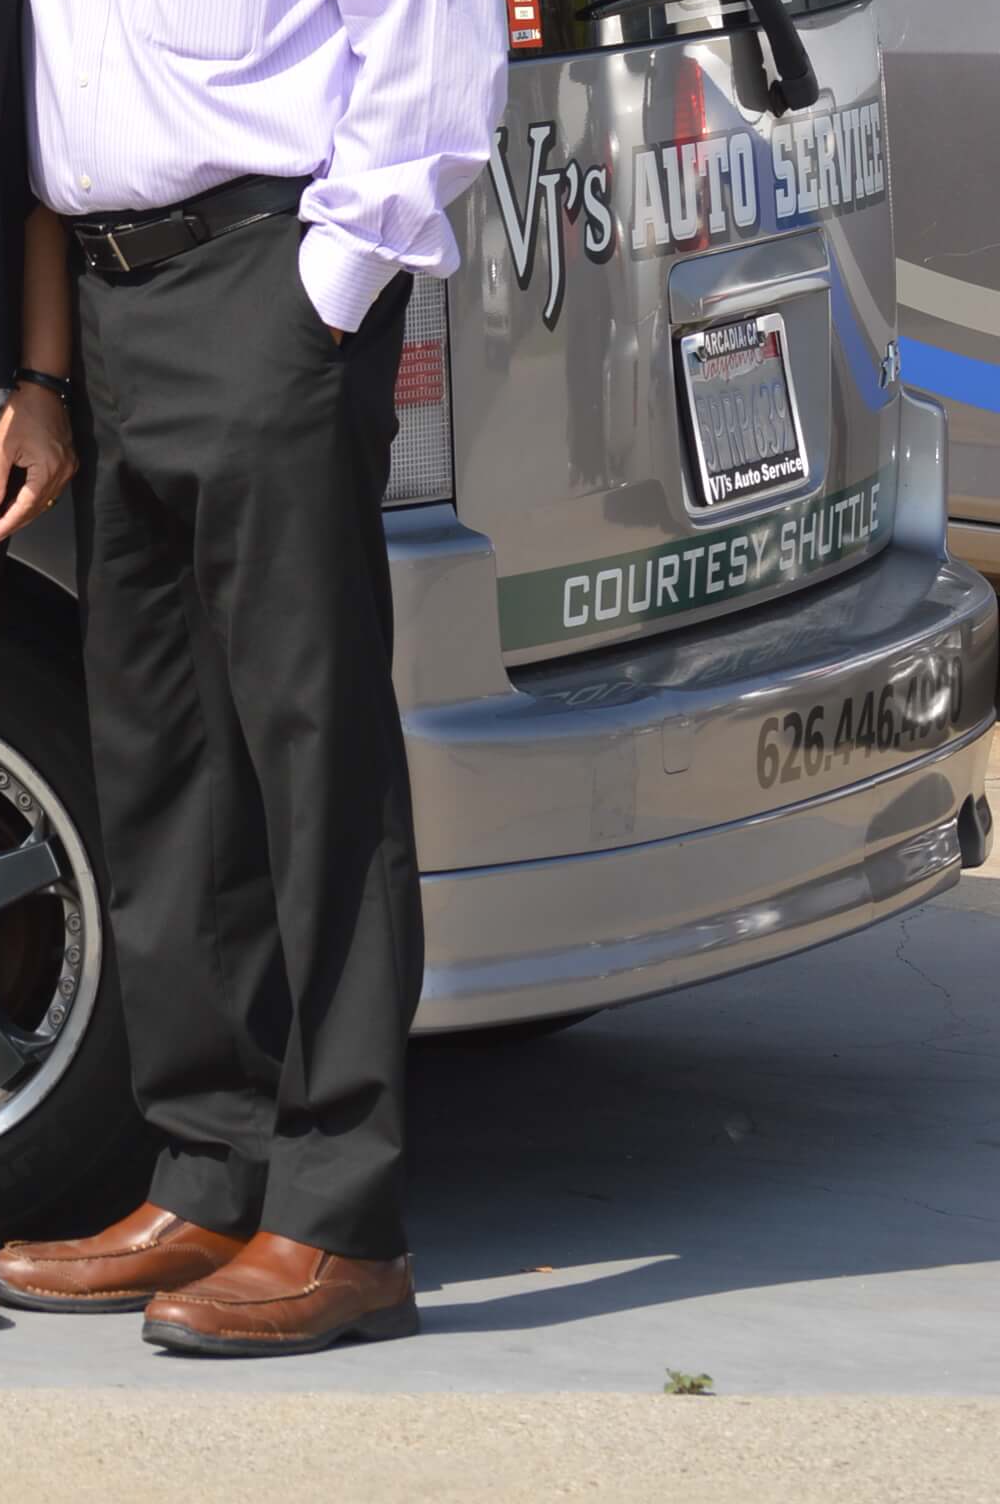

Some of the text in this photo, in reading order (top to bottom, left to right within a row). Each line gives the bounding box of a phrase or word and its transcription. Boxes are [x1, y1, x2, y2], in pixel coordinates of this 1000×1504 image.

[632, 132, 758, 253] AUTO
[773, 103, 885, 222] SERVICE
[734, 468, 761, 490] Auto
[761, 456, 803, 483] Service
[563, 483, 881, 628] COURTESY SHUTTLE
